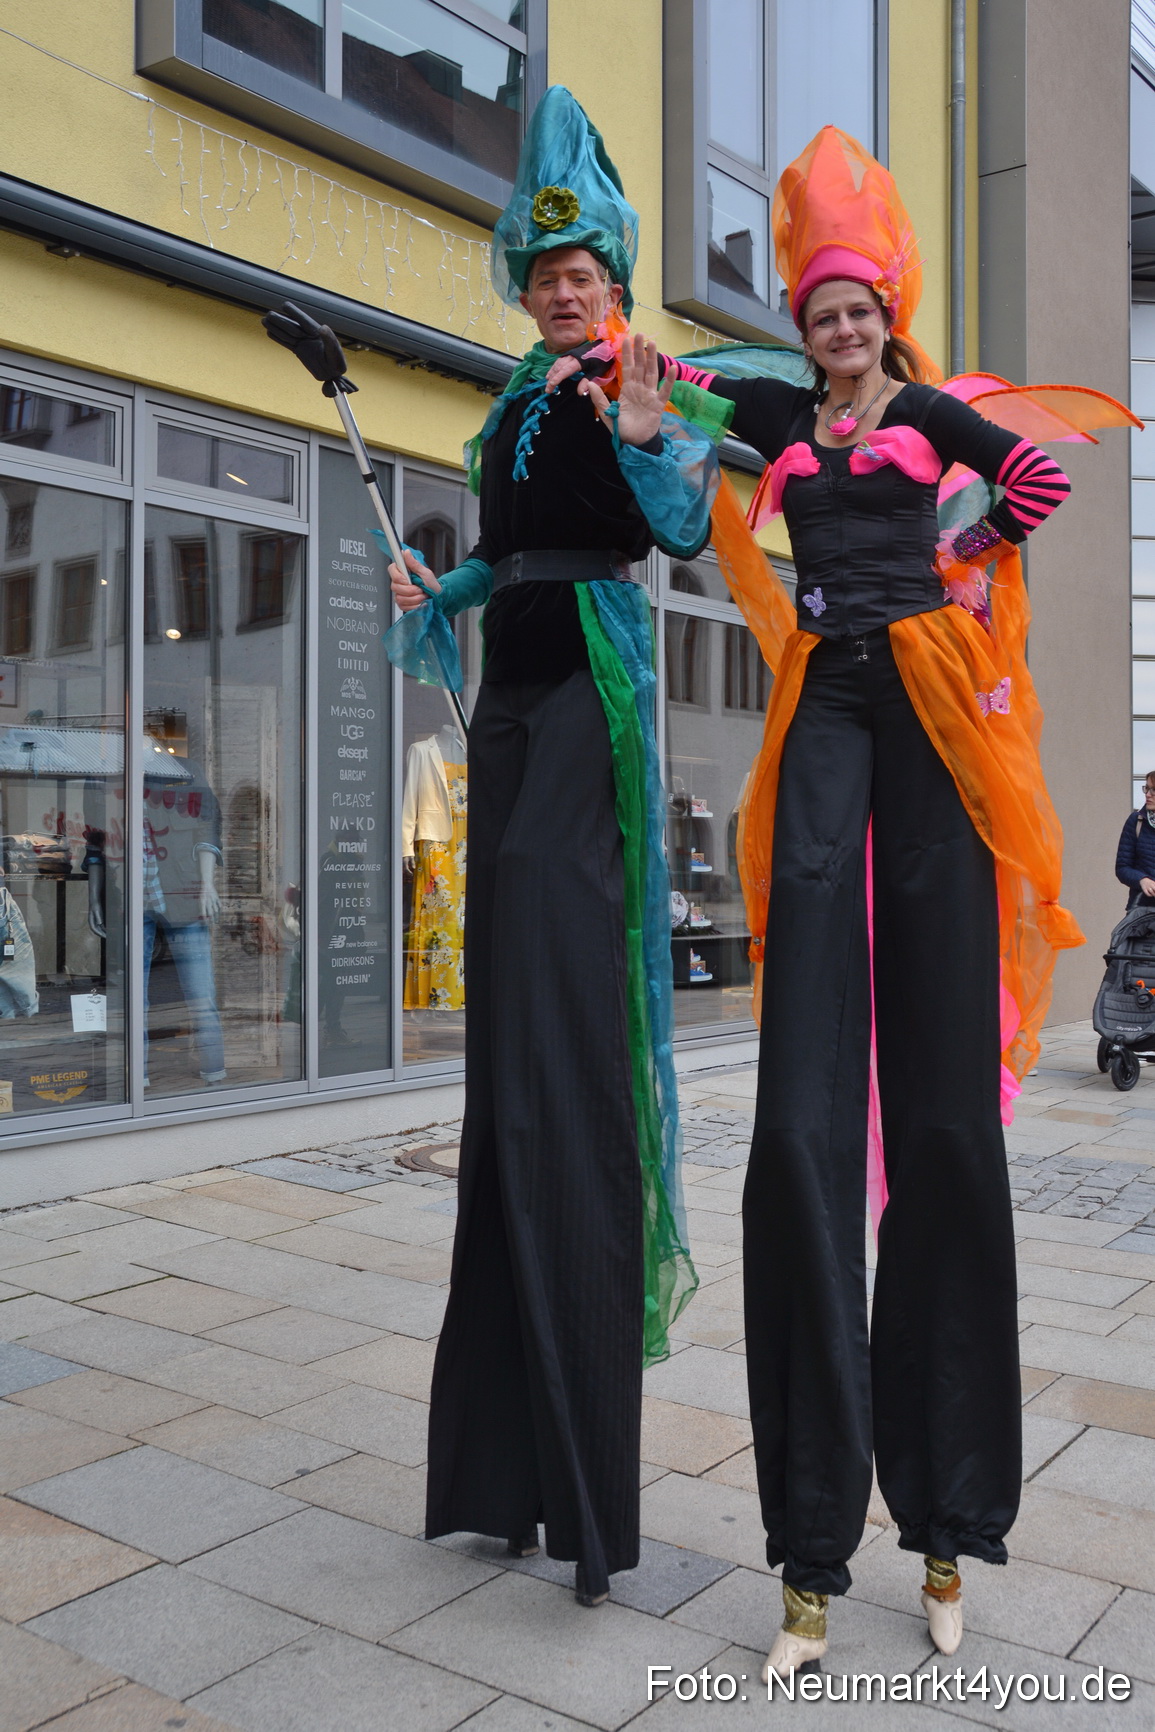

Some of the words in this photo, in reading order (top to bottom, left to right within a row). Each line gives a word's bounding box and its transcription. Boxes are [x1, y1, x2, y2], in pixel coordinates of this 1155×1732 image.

[339, 538, 367, 558] DIESEL
[331, 560, 352, 573] SURI
[352, 564, 375, 576] FREY
[329, 596, 364, 611] adidas
[326, 616, 380, 636] NOBRAND
[338, 640, 368, 653] ONLY
[337, 657, 369, 672] EDITED
[330, 705, 375, 720] MANGO
[340, 725, 364, 740] UGG
[337, 745, 369, 762] eksept
[338, 839, 368, 853] mavi
[334, 897, 371, 908] PIECES
[331, 956, 375, 968] DIDRIKSONS
[30, 1074, 51, 1085] PME
[52, 1070, 88, 1082] LEGEND
